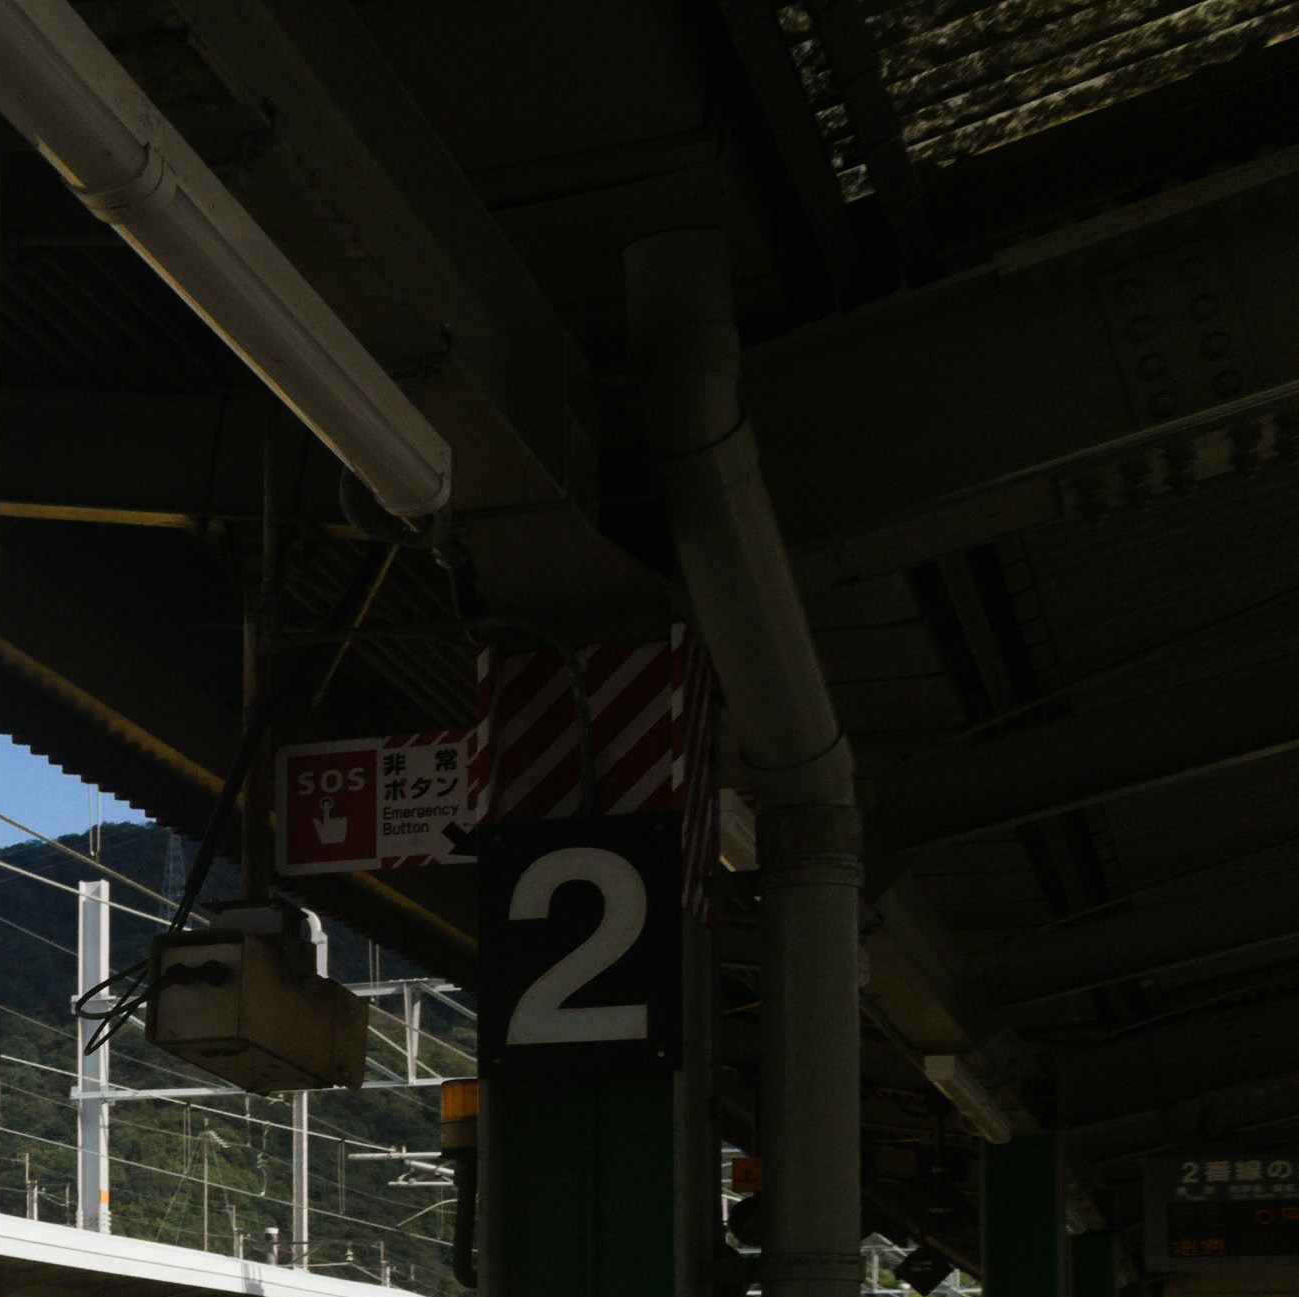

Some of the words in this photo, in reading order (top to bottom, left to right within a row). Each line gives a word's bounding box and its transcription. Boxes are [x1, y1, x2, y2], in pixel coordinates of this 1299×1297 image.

[383, 749, 457, 776] 非常
[298, 767, 366, 796] SOS
[384, 777, 458, 800] ボタン
[383, 805, 459, 819] Emergency
[383, 822, 429, 835] Button
[506, 847, 648, 1045] 2
[1181, 1160, 1299, 1183] 2番線の
